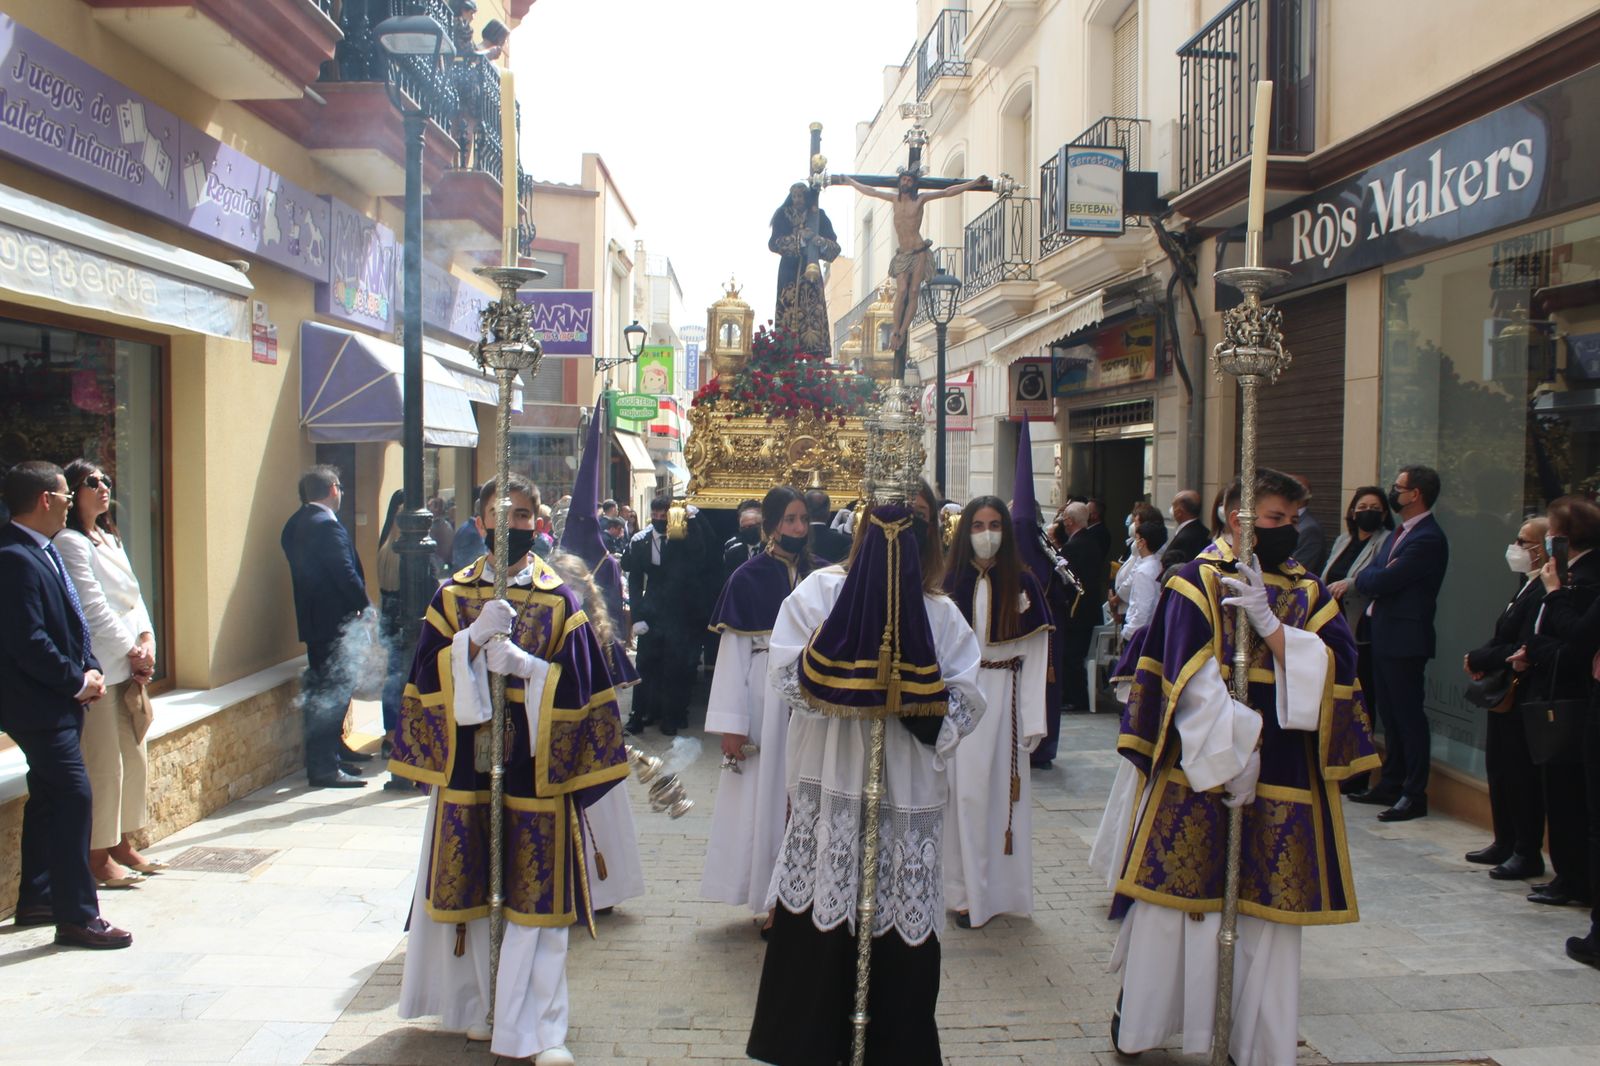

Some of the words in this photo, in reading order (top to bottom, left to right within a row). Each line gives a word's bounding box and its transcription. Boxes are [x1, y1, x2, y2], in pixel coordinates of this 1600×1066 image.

[12, 52, 84, 113] Juegos
[90, 92, 113, 127] de
[67, 122, 146, 185] Infantiles
[205, 172, 261, 222] Regalos
[1069, 203, 1114, 215] ESTEBAN
[1367, 138, 1534, 241] Makers
